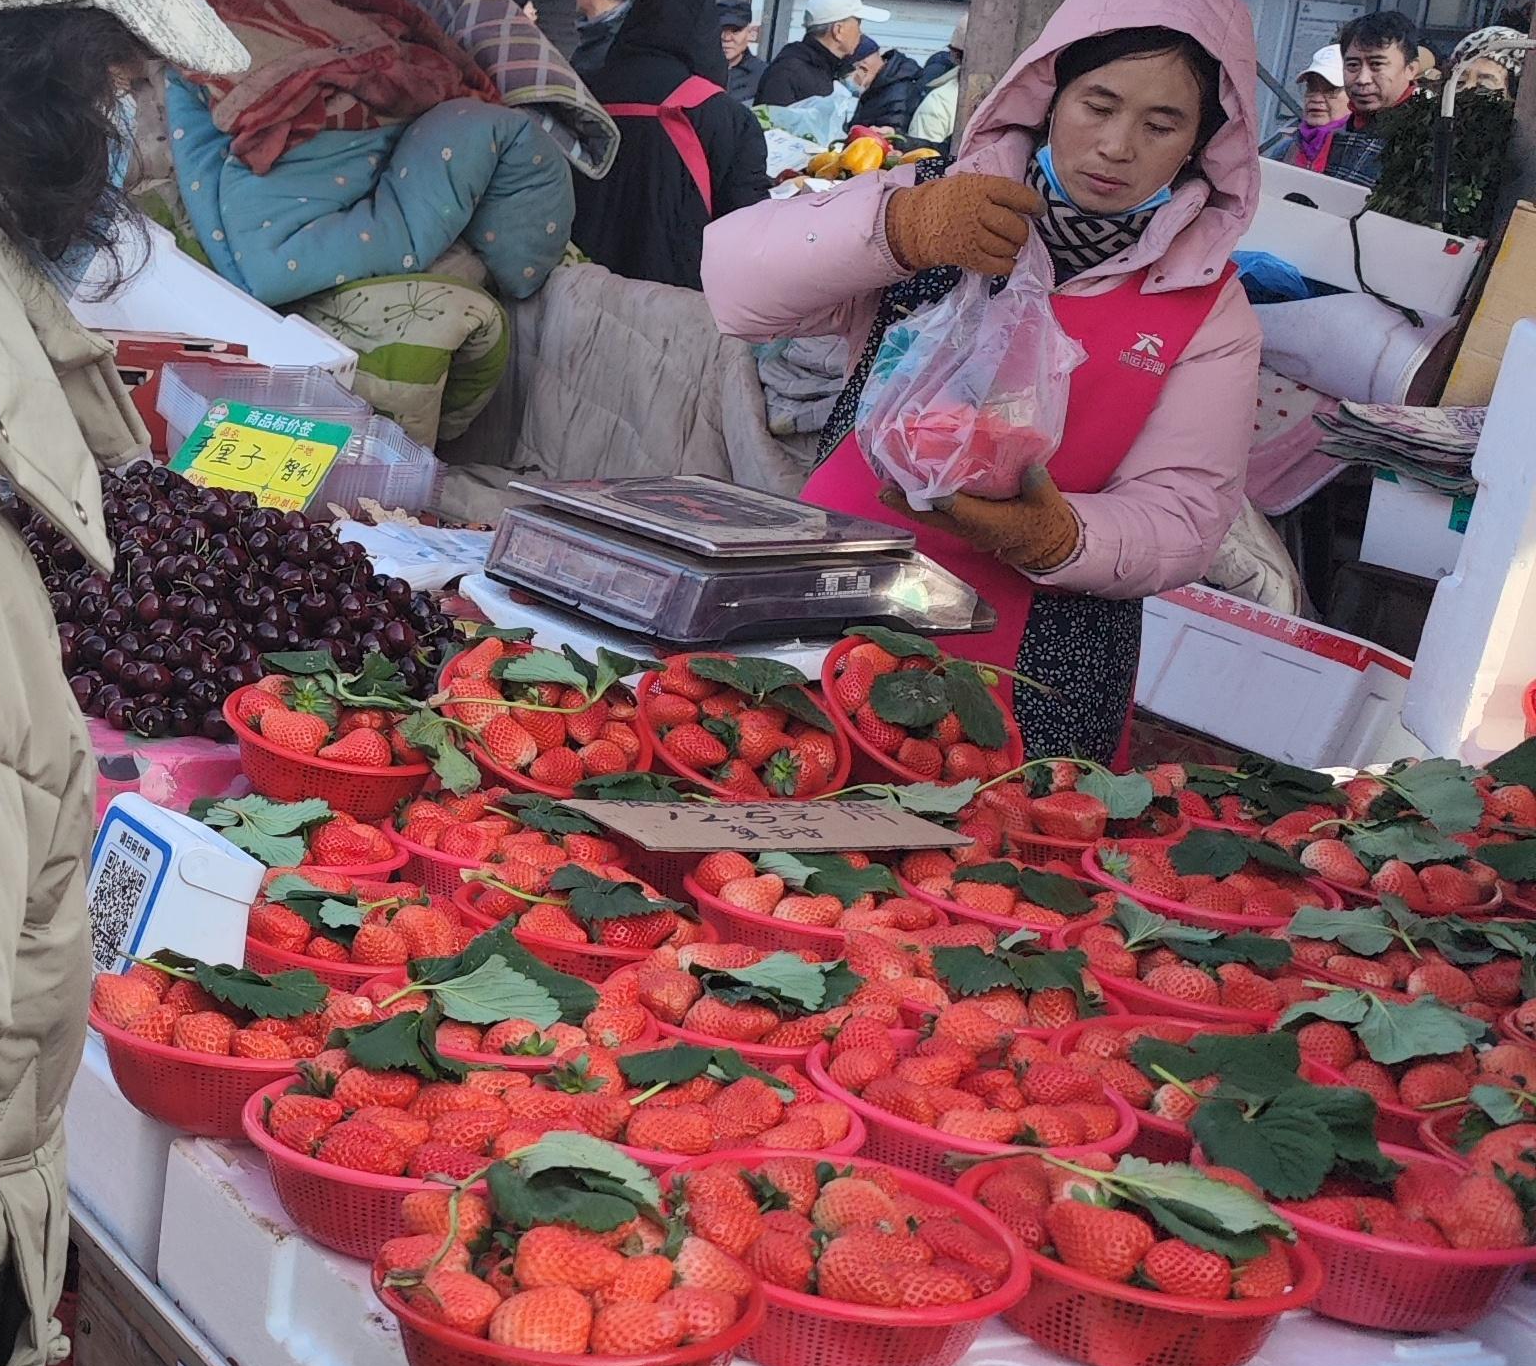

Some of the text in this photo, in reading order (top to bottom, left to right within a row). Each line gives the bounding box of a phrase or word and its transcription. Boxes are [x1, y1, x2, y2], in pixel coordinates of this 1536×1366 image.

[243, 410, 317, 438] 商品标价签
[191, 434, 267, 471] 车厘子
[281, 457, 322, 488] 智利
[120, 830, 151, 863] 请扫码付款
